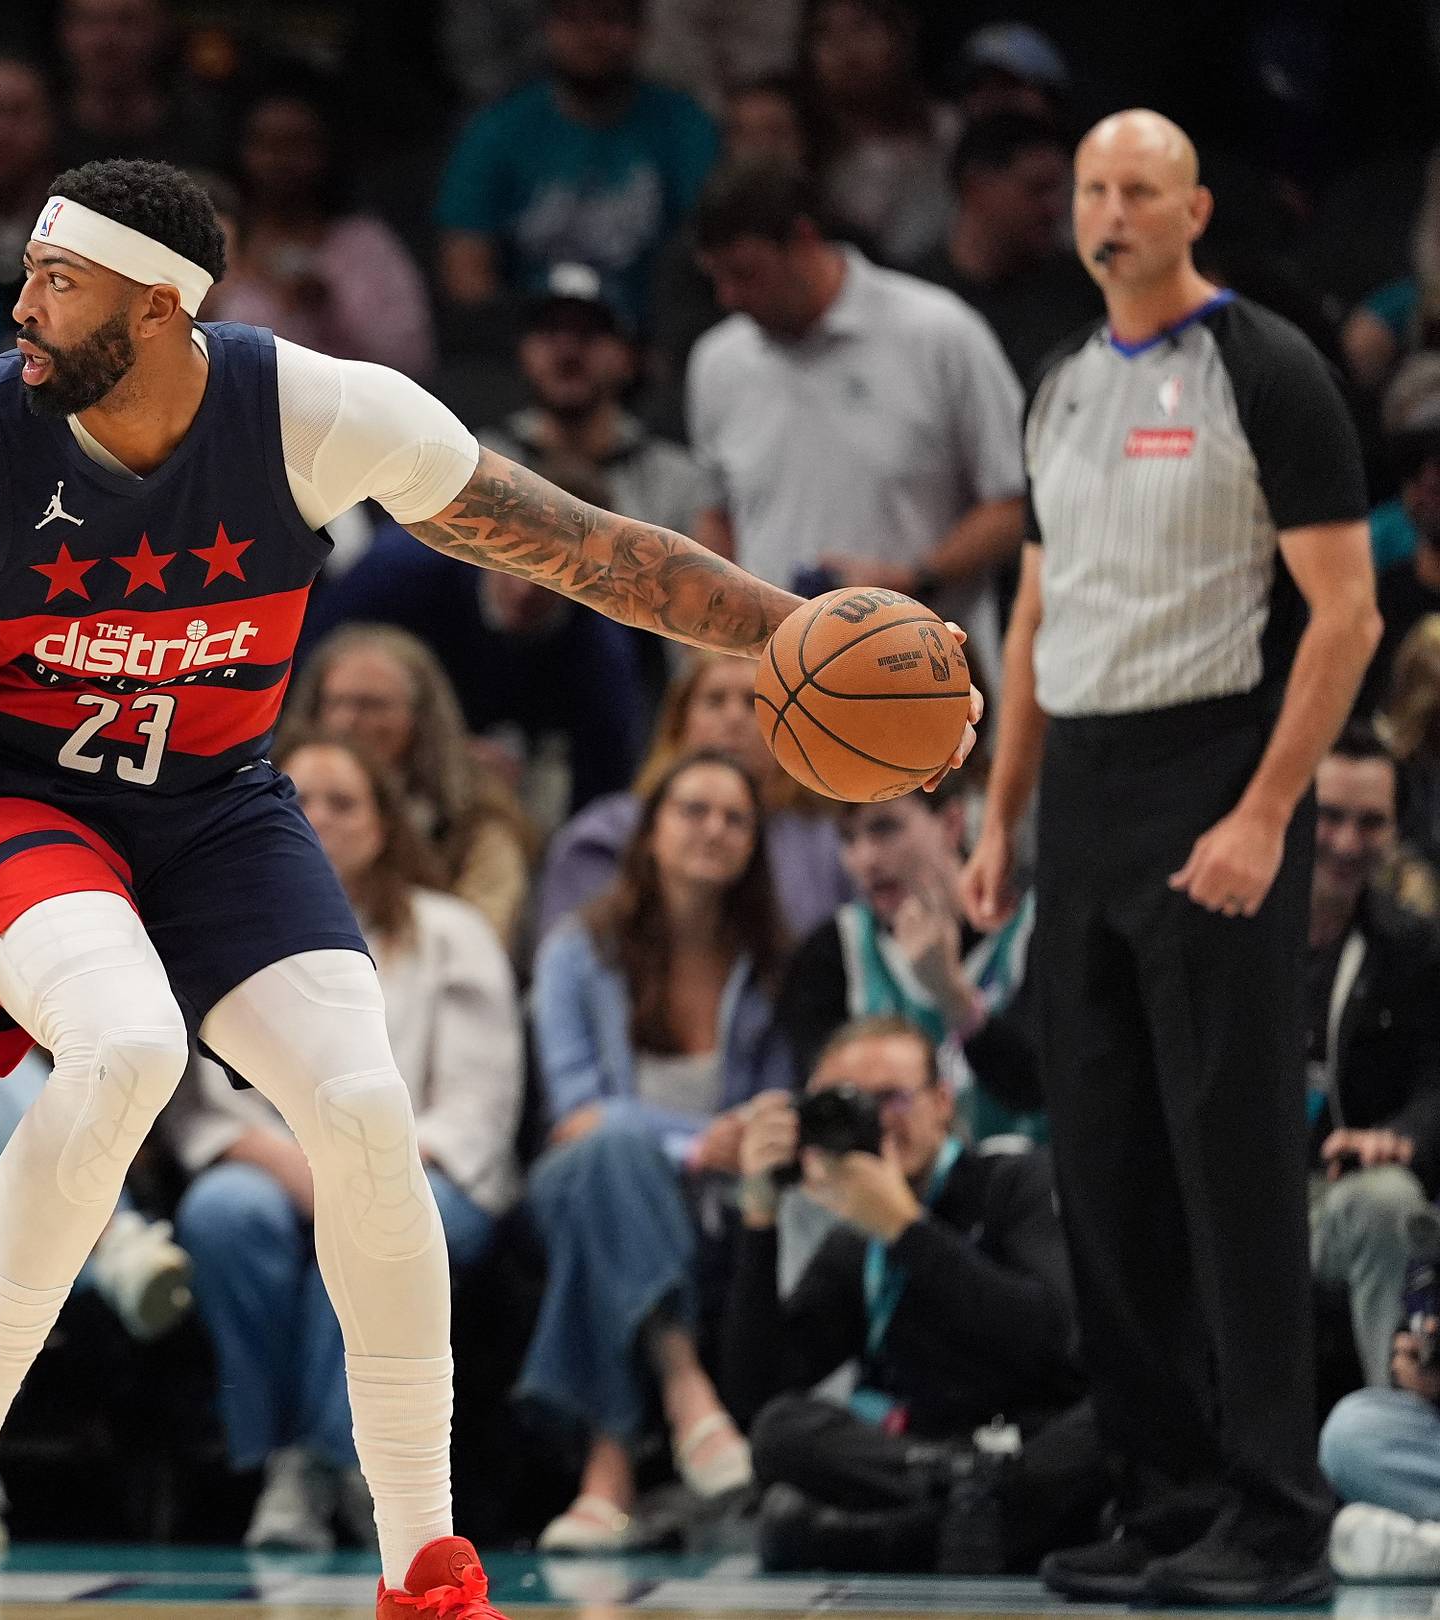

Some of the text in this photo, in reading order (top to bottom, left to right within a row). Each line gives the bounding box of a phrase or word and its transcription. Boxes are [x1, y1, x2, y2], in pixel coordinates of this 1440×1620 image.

[34, 619, 259, 676] district
[96, 623, 133, 640] THE
[36, 663, 60, 684] OF
[57, 693, 177, 786] 23
